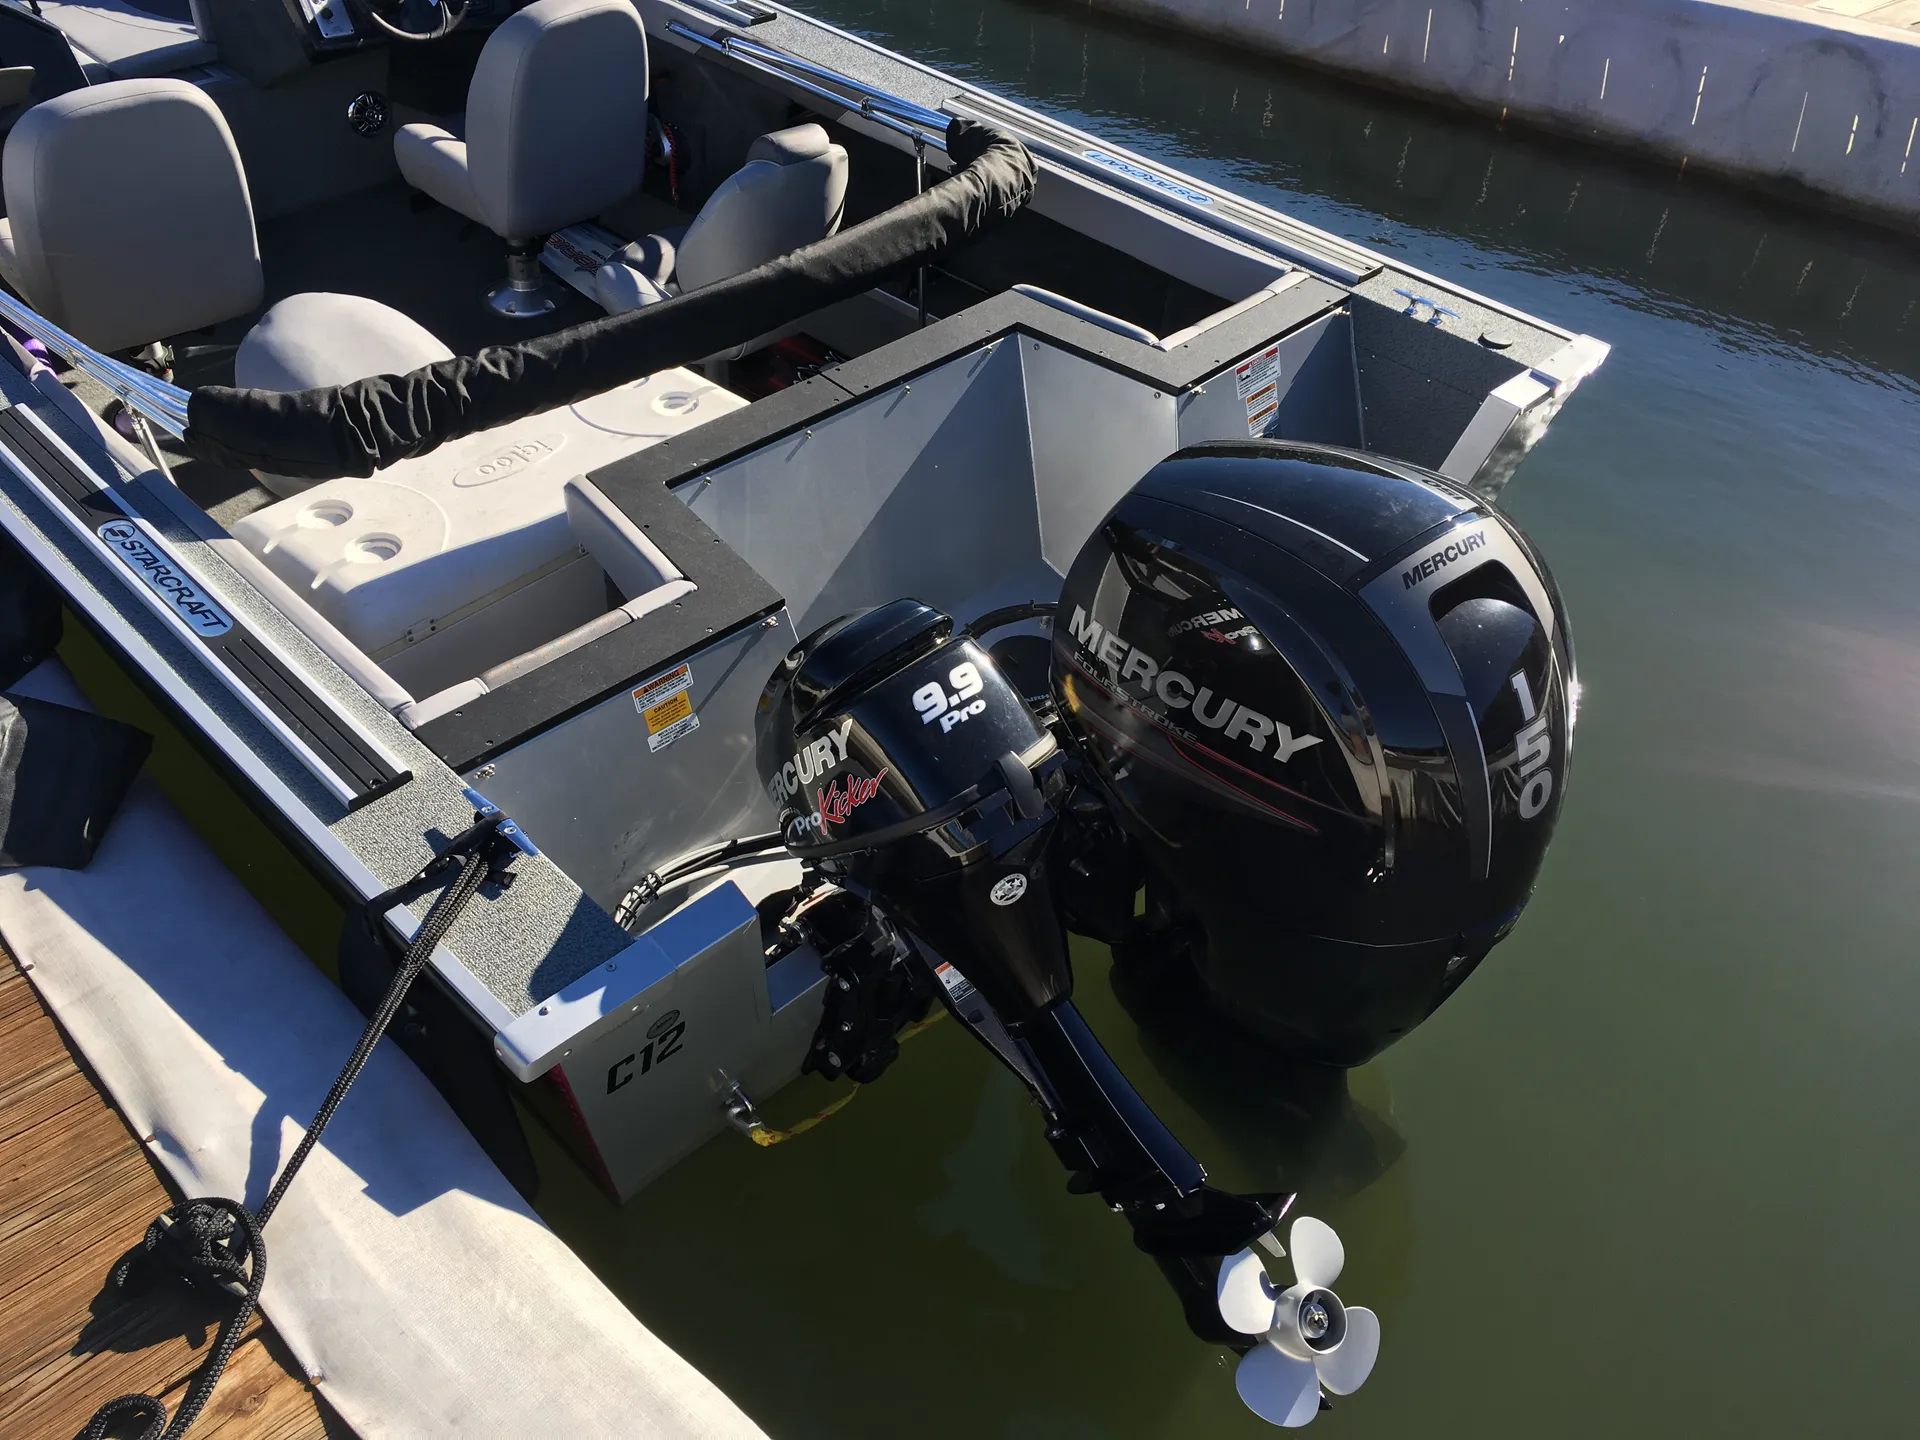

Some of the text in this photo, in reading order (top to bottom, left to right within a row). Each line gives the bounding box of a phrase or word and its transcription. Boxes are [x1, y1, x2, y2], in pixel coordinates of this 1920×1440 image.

[1090, 152, 1190, 196] STARCRAFT
[476, 440, 553, 475] igloo
[120, 539, 228, 629] STARCRAFT
[1402, 530, 1486, 590] MERCURY
[653, 697, 678, 713] CAUTION
[912, 661, 984, 725] 9.9
[1069, 604, 1323, 763] MERCURY
[939, 699, 987, 734] Pro
[1510, 668, 1553, 821] 150
[767, 718, 853, 811] ERCURY
[606, 1020, 686, 1095] C12
